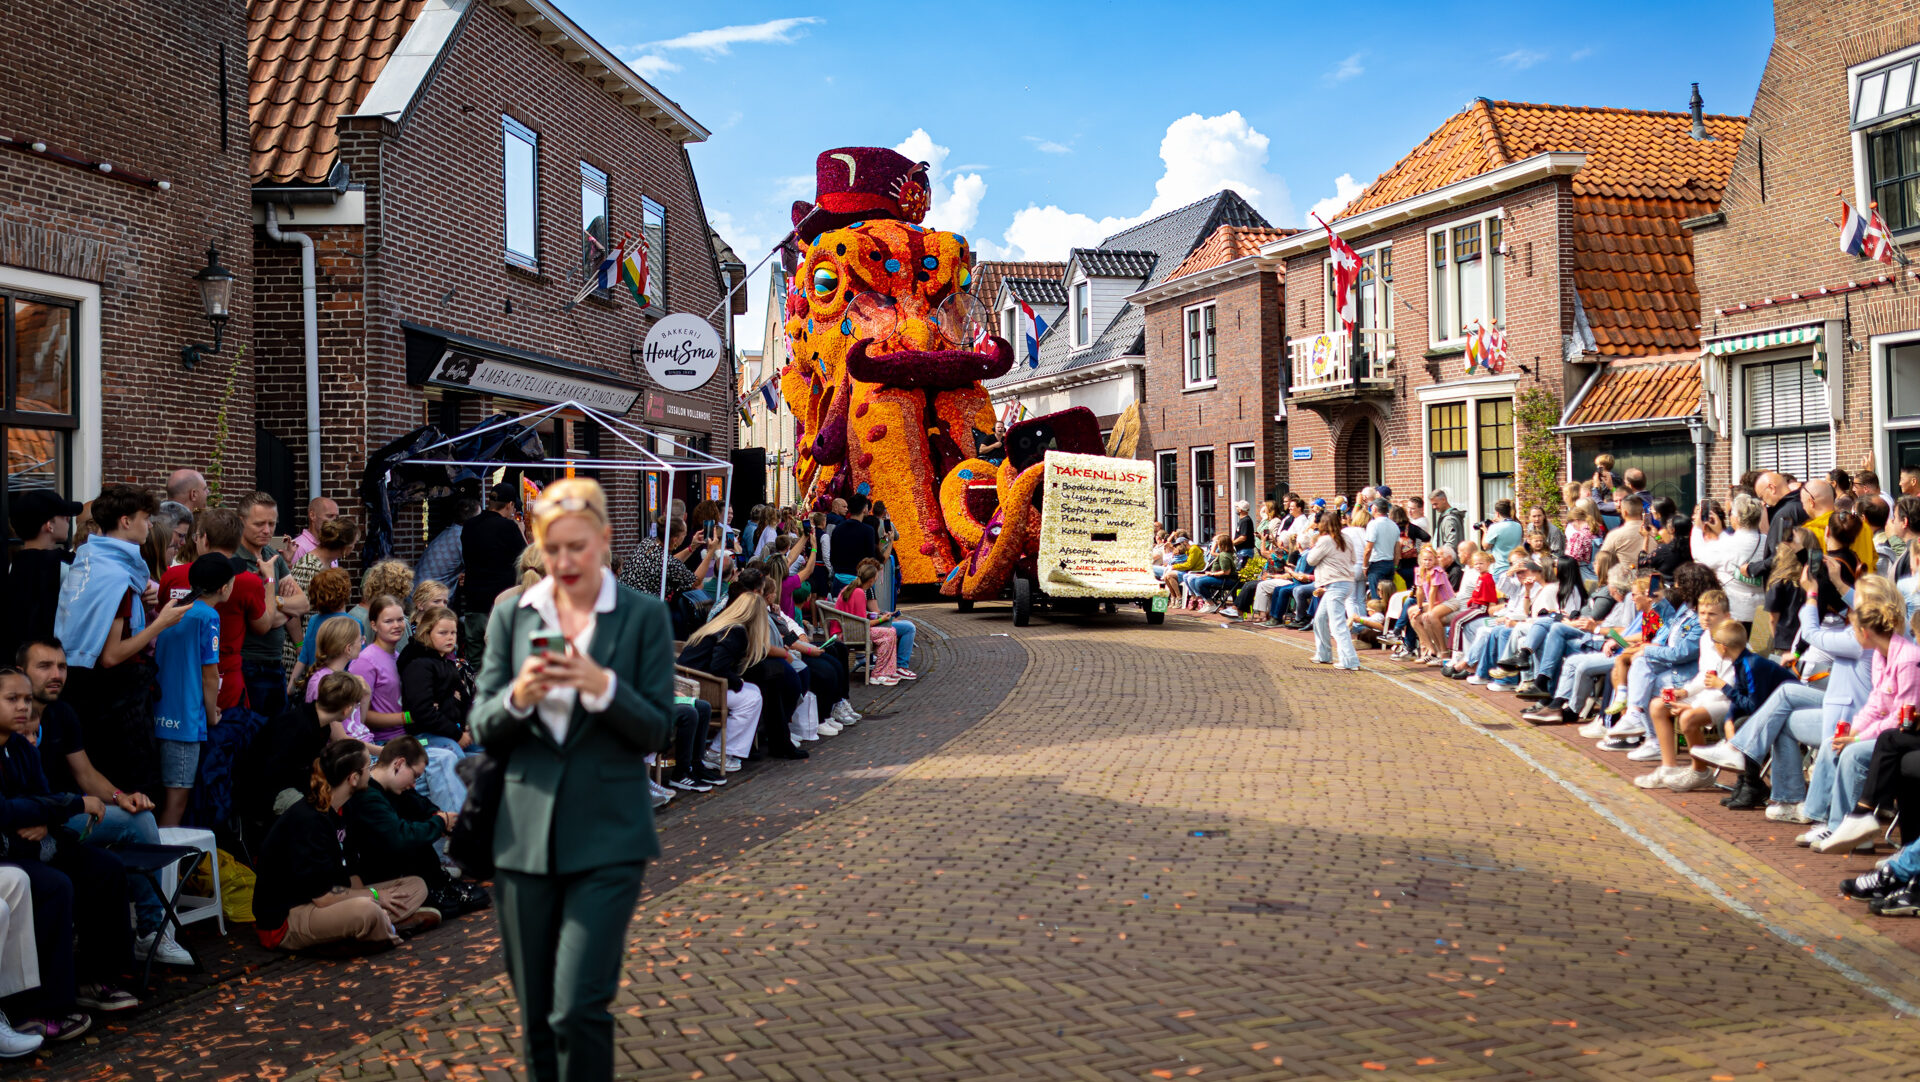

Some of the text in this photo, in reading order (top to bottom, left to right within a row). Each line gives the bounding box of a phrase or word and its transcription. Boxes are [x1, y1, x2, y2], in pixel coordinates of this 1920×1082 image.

[661, 328, 701, 339] BAKKERIJ
[645, 340, 717, 366] HoutSma
[478, 367, 557, 395] AMBACHTELIJKE
[555, 383, 591, 400] BAKKER
[588, 389, 615, 404] SINDS
[613, 395, 634, 408] 1945
[1052, 464, 1147, 484] TAKENLIJST
[1100, 496, 1111, 504] op
[1061, 515, 1086, 523] Plant
[1061, 527, 1088, 535] Koken
[1059, 547, 1099, 556] Afstoffen
